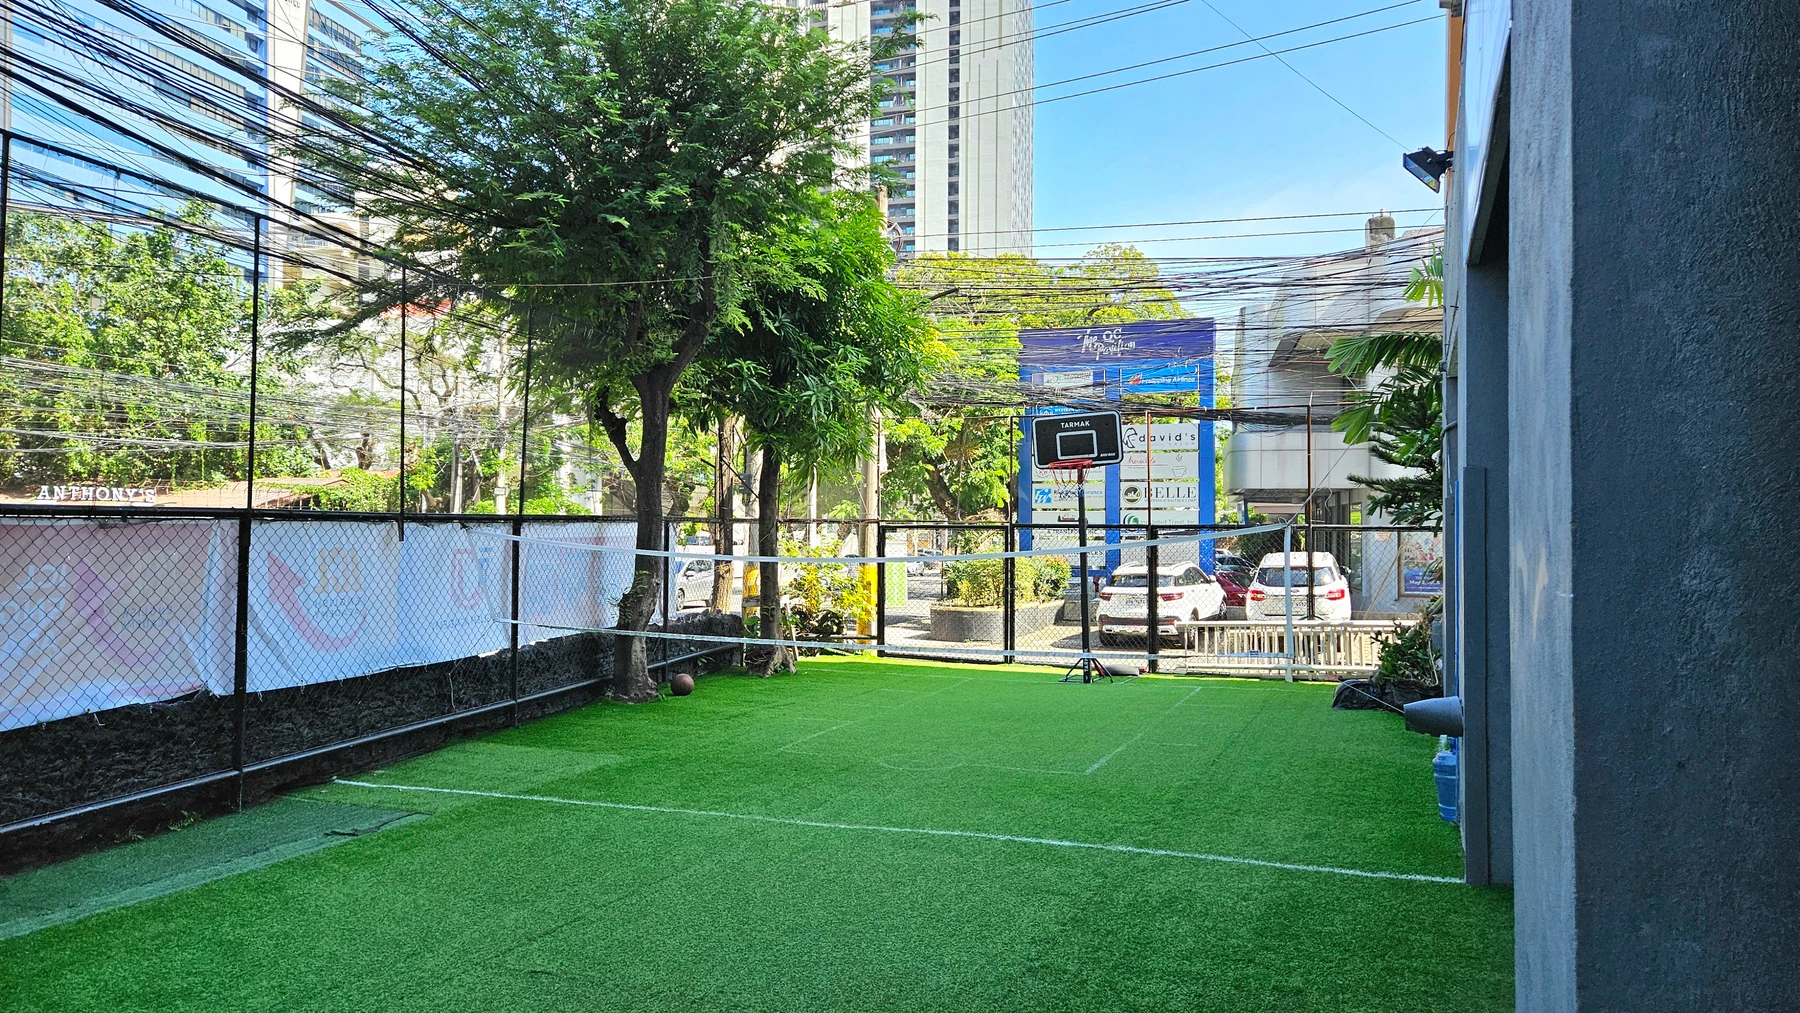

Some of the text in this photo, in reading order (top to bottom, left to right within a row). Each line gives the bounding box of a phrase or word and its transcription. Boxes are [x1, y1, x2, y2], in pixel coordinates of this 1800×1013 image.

[1102, 327, 1122, 343] QC
[1095, 338, 1136, 361] Pavilion
[1172, 375, 1196, 383] Airlines
[1060, 420, 1091, 429] TARMAK
[1138, 432, 1196, 442] david's
[36, 485, 156, 503] ANTHONY'S
[1144, 486, 1197, 499] BELLE
